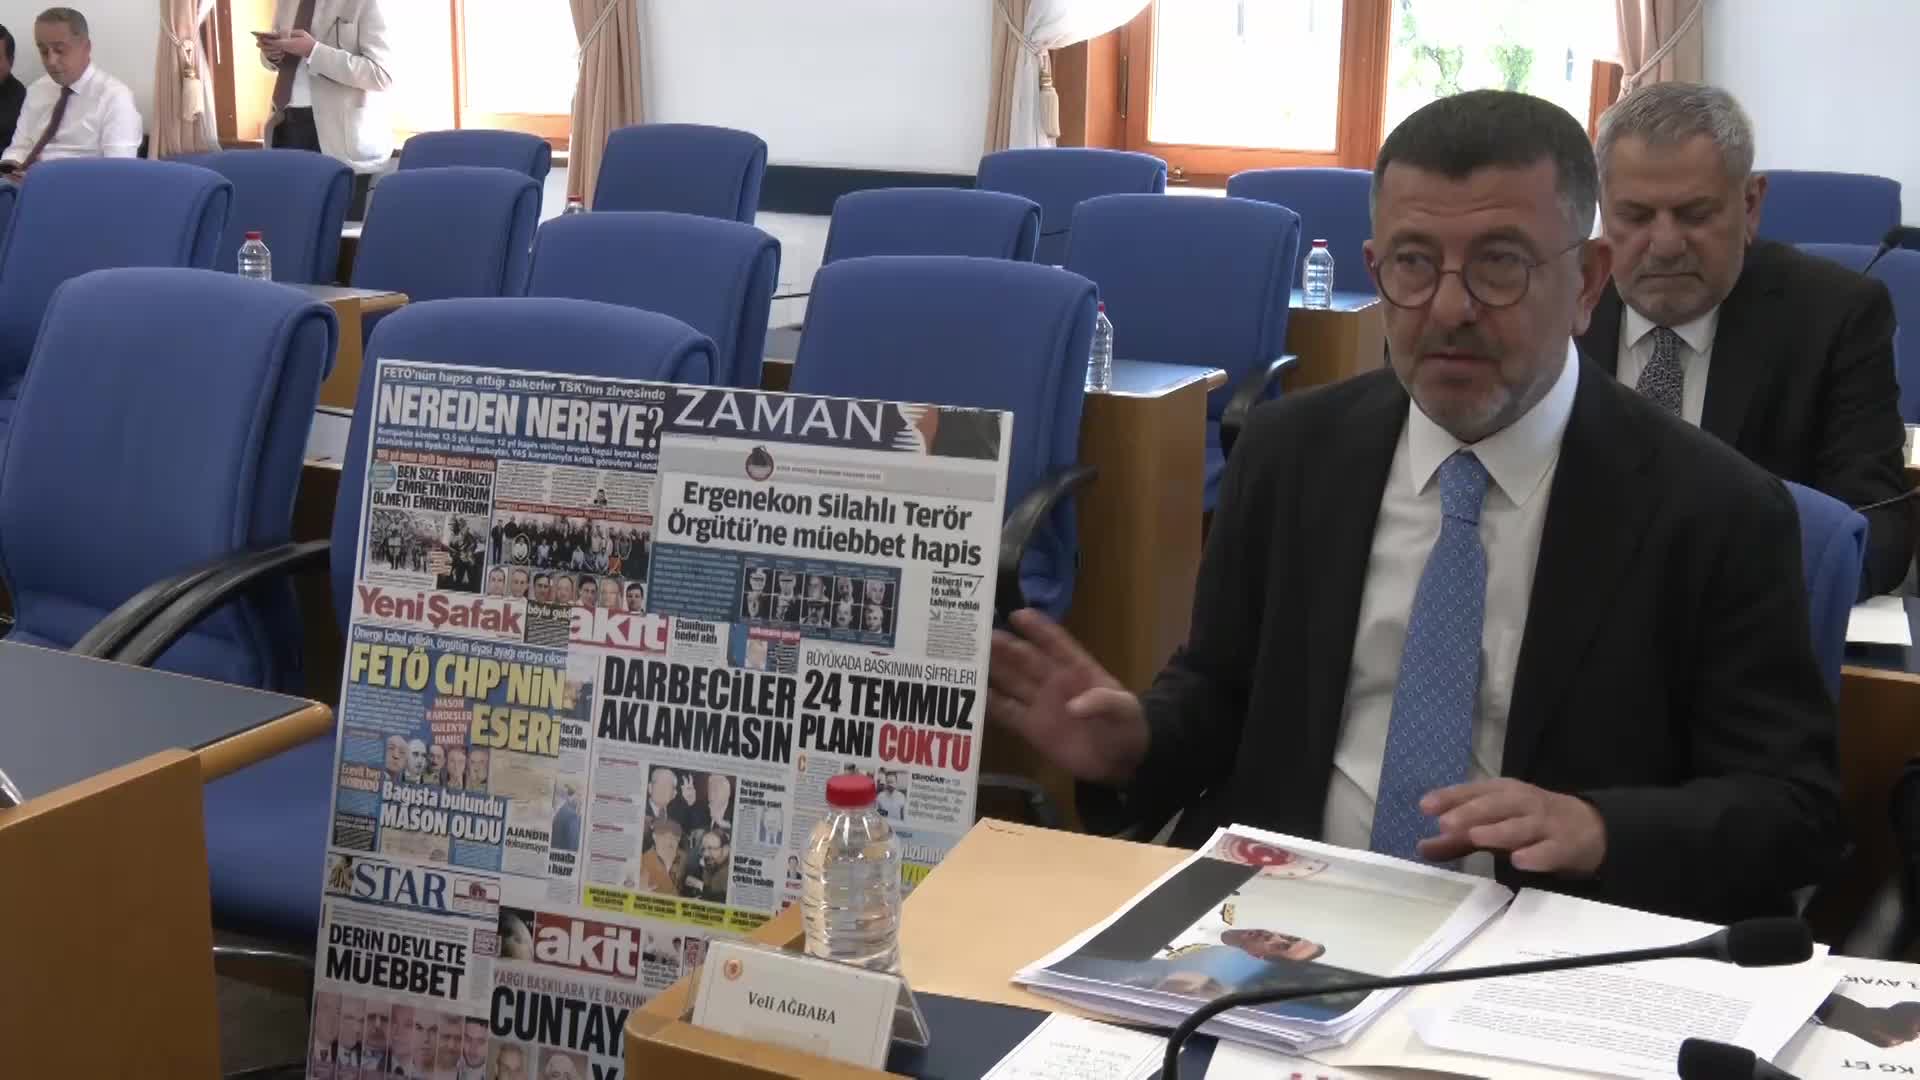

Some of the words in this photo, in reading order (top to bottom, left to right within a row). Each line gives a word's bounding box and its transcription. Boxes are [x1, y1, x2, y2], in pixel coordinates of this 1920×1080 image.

[378, 384, 520, 437] NEREDEN
[525, 396, 664, 449] NEREYE?
[606, 384, 666, 400] zirvesinde
[673, 388, 885, 443] ZAMAN
[397, 465, 418, 480] BEN
[442, 469, 492, 486] TAARRUZU
[683, 480, 812, 516] Ergenekon
[818, 493, 896, 525] Silahlı
[904, 500, 972, 531] Terör
[668, 507, 788, 547] Örgütü'ne
[793, 526, 906, 559] müebbet
[912, 534, 982, 569] hapis
[358, 584, 425, 622] Yeni
[427, 593, 522, 633] Şafak
[350, 641, 429, 691] FETÖ
[806, 650, 862, 672] BÜYÜKADA
[802, 669, 842, 712] 24
[848, 675, 976, 731] TEMMUZ
[598, 699, 793, 764] AKLANMASIN
[798, 714, 874, 758] PLANI
[381, 803, 448, 836] MASON
[451, 815, 504, 845] OLDU
[441, 789, 504, 817] bulundu
[355, 863, 447, 911] STAR
[325, 946, 465, 1000] MÜEBBET
[387, 933, 467, 966] DEVLETE
[536, 920, 638, 977] akit
[494, 969, 523, 987] YARGI
[527, 974, 585, 998] BASKILARA
[589, 985, 601, 1001] VE
[749, 992, 775, 1010] Veli
[776, 997, 835, 1024] AĞBABA
[490, 985, 629, 1057] CUNTAY
